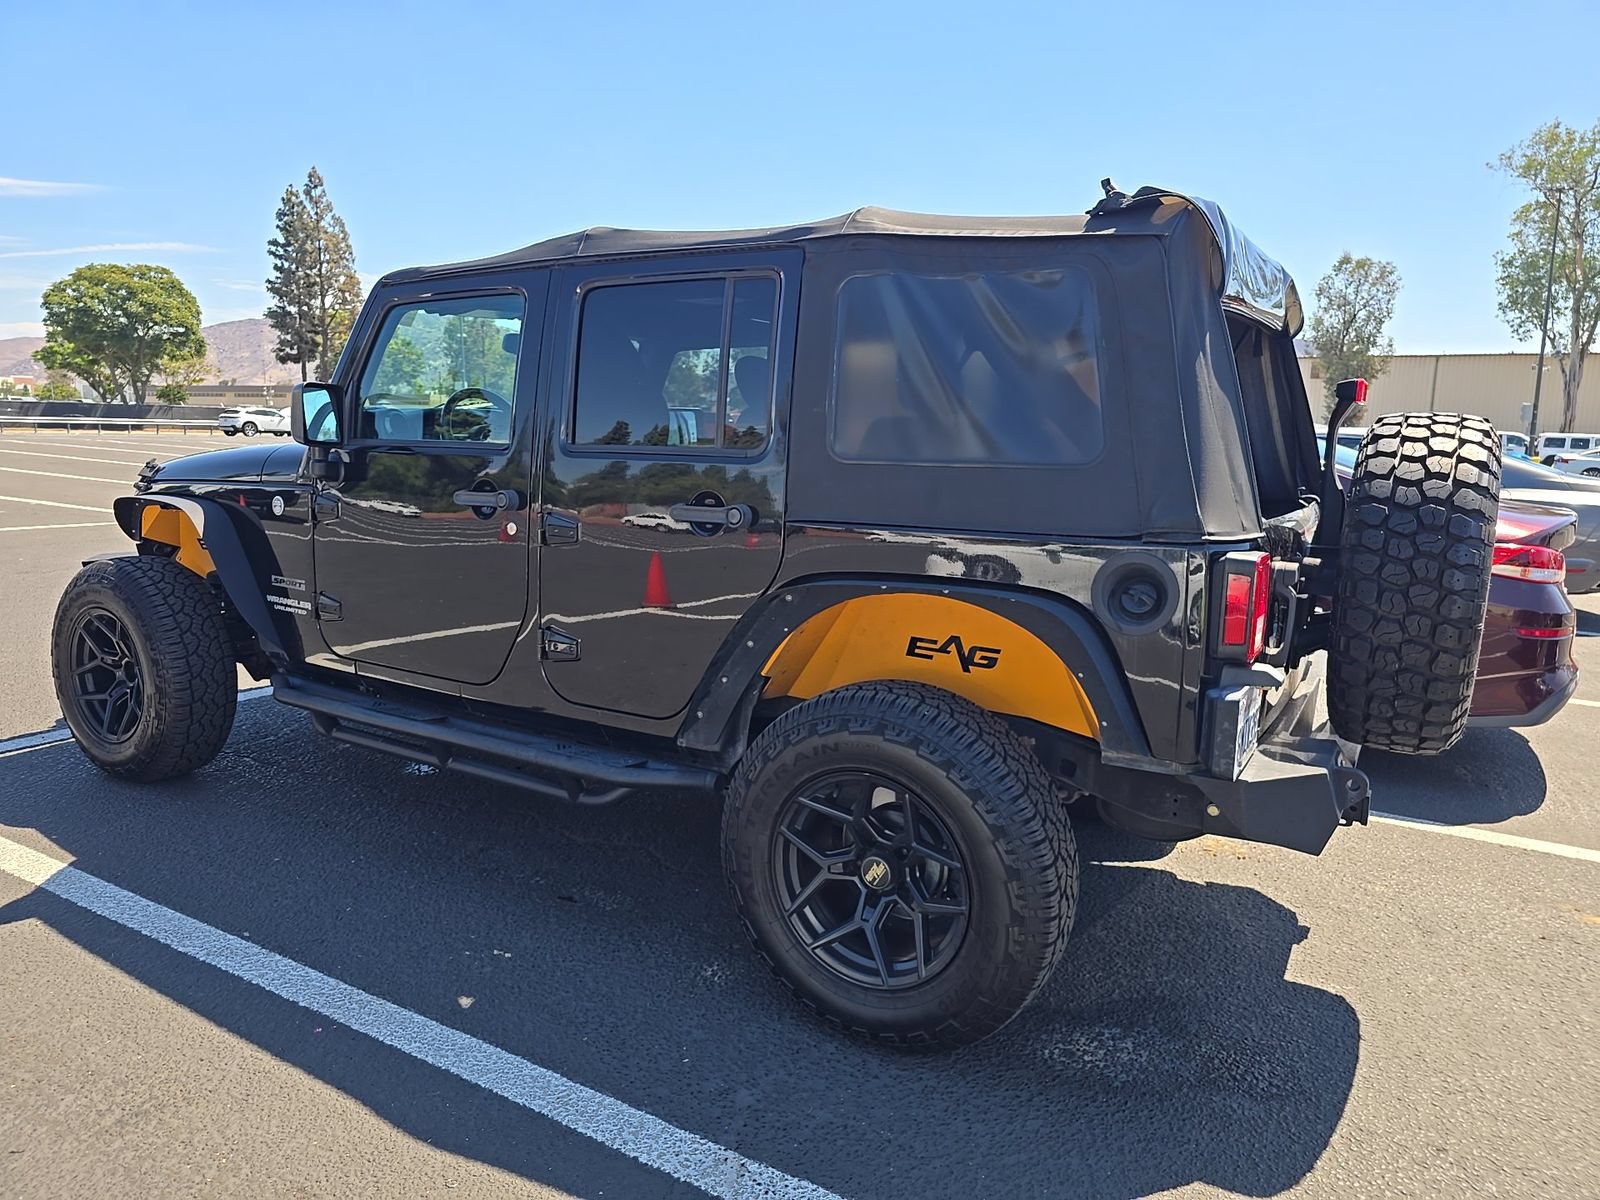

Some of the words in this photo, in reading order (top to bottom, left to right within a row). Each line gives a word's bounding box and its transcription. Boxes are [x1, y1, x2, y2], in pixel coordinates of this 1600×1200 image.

[272, 577, 304, 590] SPORT
[267, 595, 312, 610] WRANGLER
[274, 604, 308, 615] UNLIMITED
[906, 636, 1002, 674] EAG
